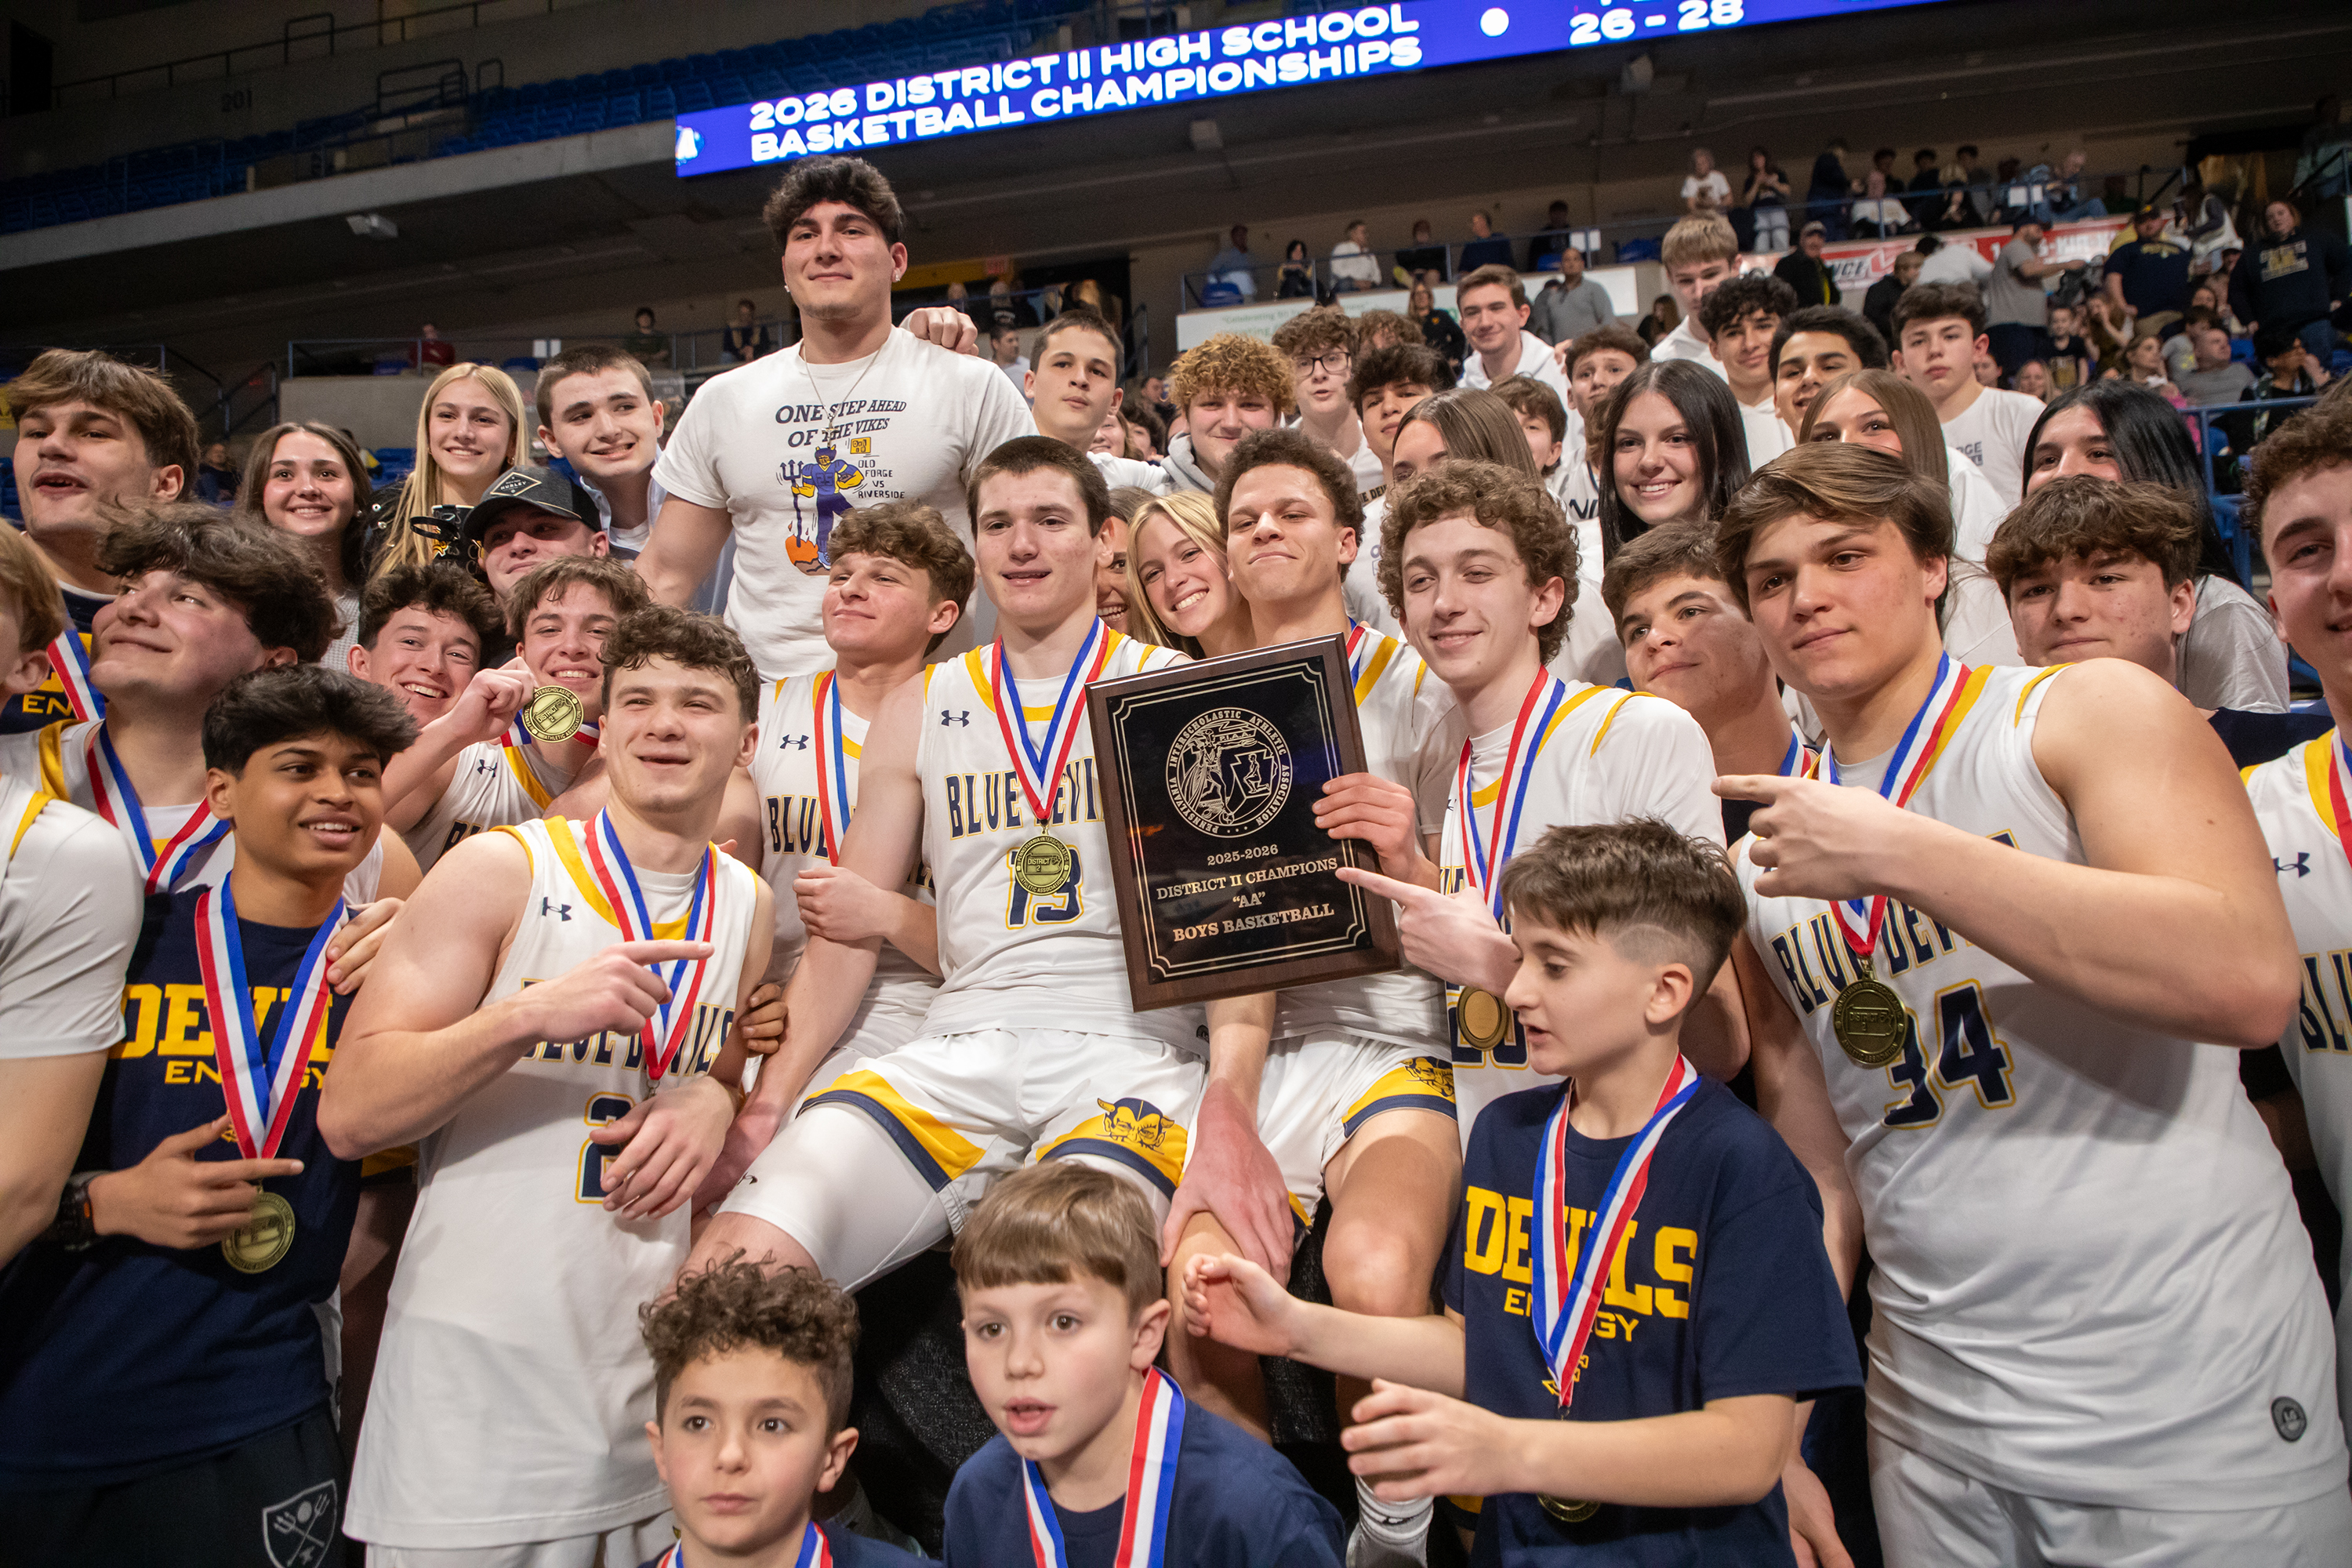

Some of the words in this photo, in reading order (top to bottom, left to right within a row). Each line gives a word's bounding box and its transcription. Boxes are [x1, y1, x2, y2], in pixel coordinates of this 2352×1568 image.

[1569, 8, 1636, 45] 26
[1644, 13, 1666, 28] -
[1678, 0, 1744, 31] 28
[750, 88, 857, 131] 2026
[866, 53, 1060, 112] DISTRICT
[1067, 49, 1091, 81] II
[1099, 31, 1211, 75] HIGH
[1221, 2, 1420, 56] SCHOOL
[222, 89, 252, 112] 201
[750, 95, 1025, 162] BASKETBALL
[1031, 36, 1423, 118] CHAMPIONSHIPS
[775, 405, 824, 424] ONE
[828, 400, 867, 419] STEP
[867, 399, 907, 412] AHEAD
[788, 429, 818, 448] OF
[822, 422, 853, 443] THE
[855, 418, 891, 434] VIKES
[858, 459, 876, 468] OLD
[500, 481, 527, 490] HURLEY
[858, 490, 906, 499] RIVERSIDE
[536, 705, 558, 723] DISTRICT
[1169, 710, 1241, 768] INTERSCHOLASTIC
[1219, 731, 1252, 742] P.I.A.A.
[1249, 716, 1287, 756] ATHLETIC
[944, 770, 1023, 840] BLUE
[1169, 776, 1220, 834] PENNSYLVANIA
[1255, 764, 1290, 826] ASSOCIATION
[1018, 837, 1040, 862] PENNSYLVANIA
[1040, 837, 1069, 861] INTERSCHOLASTIC
[1207, 844, 1279, 866] 2025-2026
[1006, 844, 1084, 930] 13
[1021, 877, 1037, 892] ATHLETIC
[1037, 877, 1064, 893] ASSOCIATION
[1156, 877, 1226, 900] DISTRICT
[1230, 876, 1243, 887] II
[1245, 858, 1338, 884] CHAMPIONS
[1173, 923, 1219, 942] BOYS
[1222, 903, 1335, 934] BASKETBALL
[1769, 912, 1860, 1018] BLU
[1883, 978, 2016, 1130] 34
[165, 1060, 326, 1090] ENY
[1464, 1185, 1698, 1319] DELS
[1504, 1287, 1639, 1341] EGY
